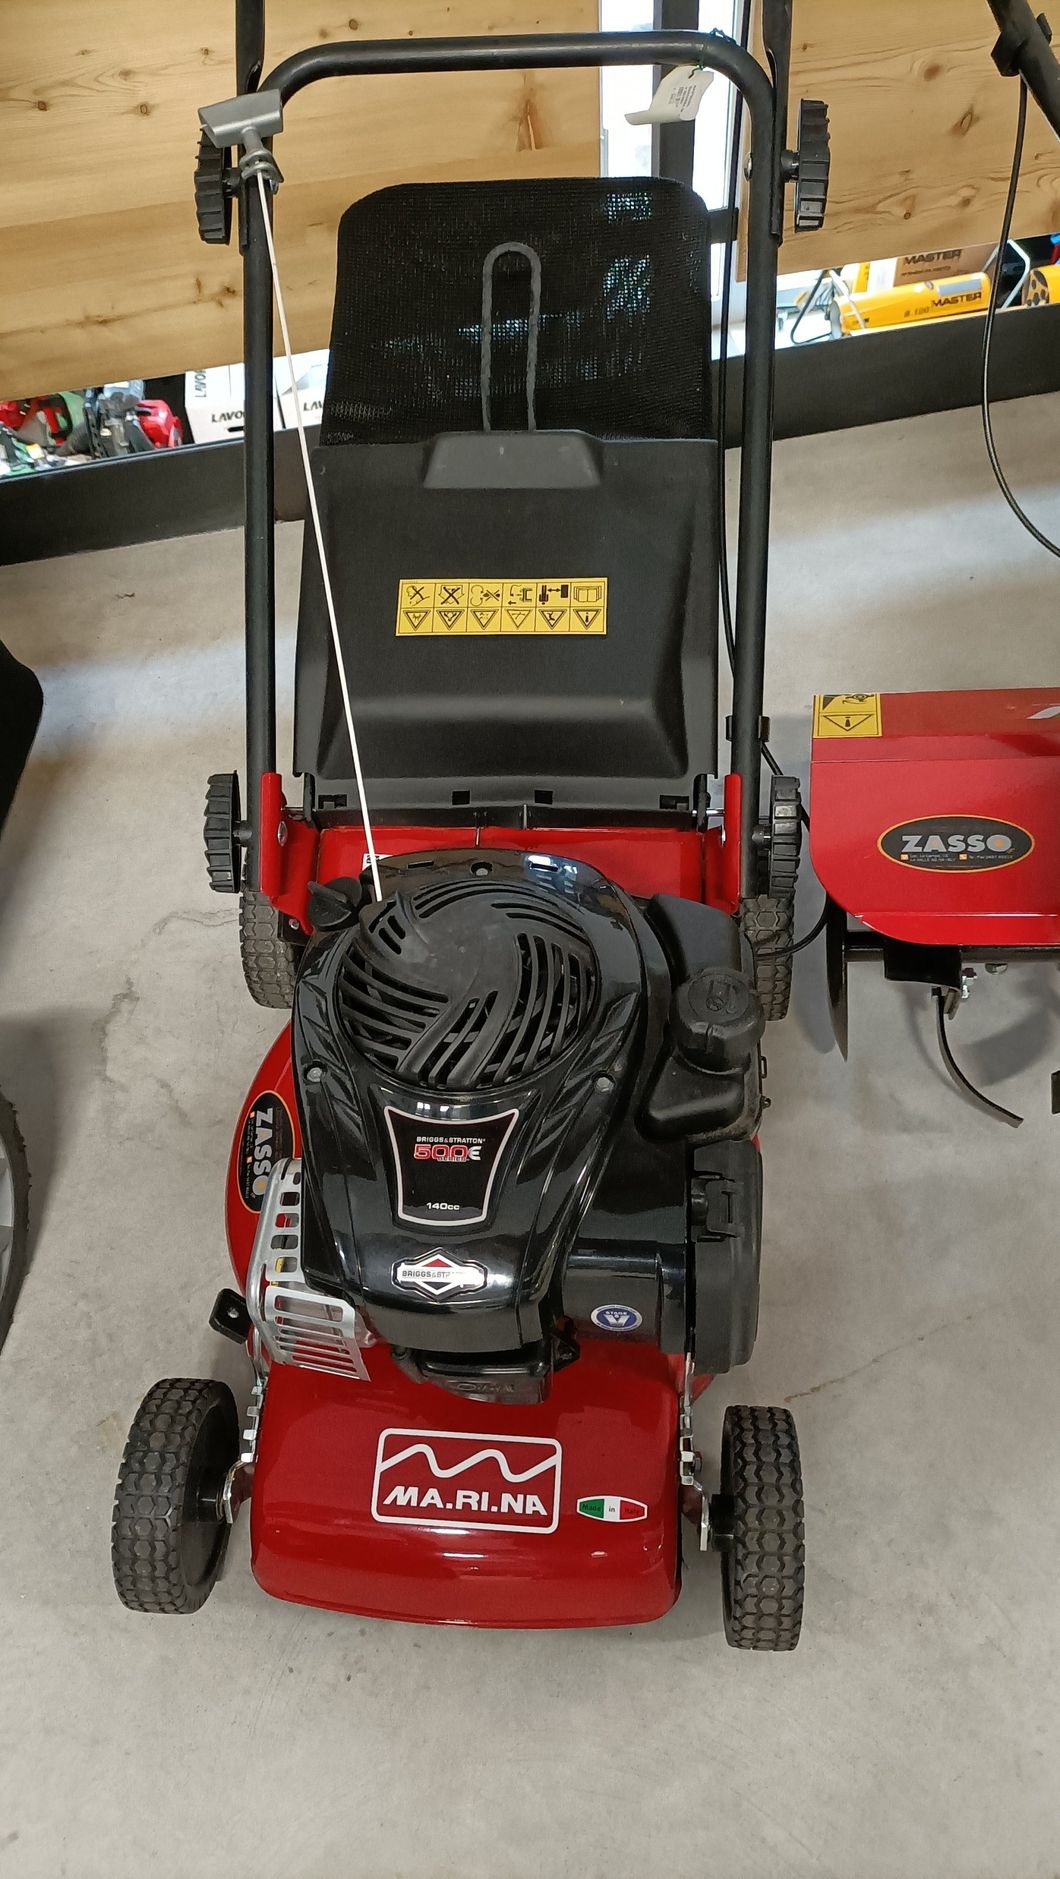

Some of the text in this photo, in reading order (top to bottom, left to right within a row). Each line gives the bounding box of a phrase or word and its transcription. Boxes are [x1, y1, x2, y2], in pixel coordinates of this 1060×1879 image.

[904, 249, 962, 265] MASTER
[931, 291, 982, 307] MASTER
[211, 410, 246, 423] LAVO
[901, 834, 1012, 853] ZASSO
[252, 1107, 273, 1195] ZASSO
[426, 1202, 460, 1211] 140cc
[382, 1485, 548, 1516] MA.RI.NA
[582, 1503, 602, 1512] Made
[608, 1505, 616, 1513] in
